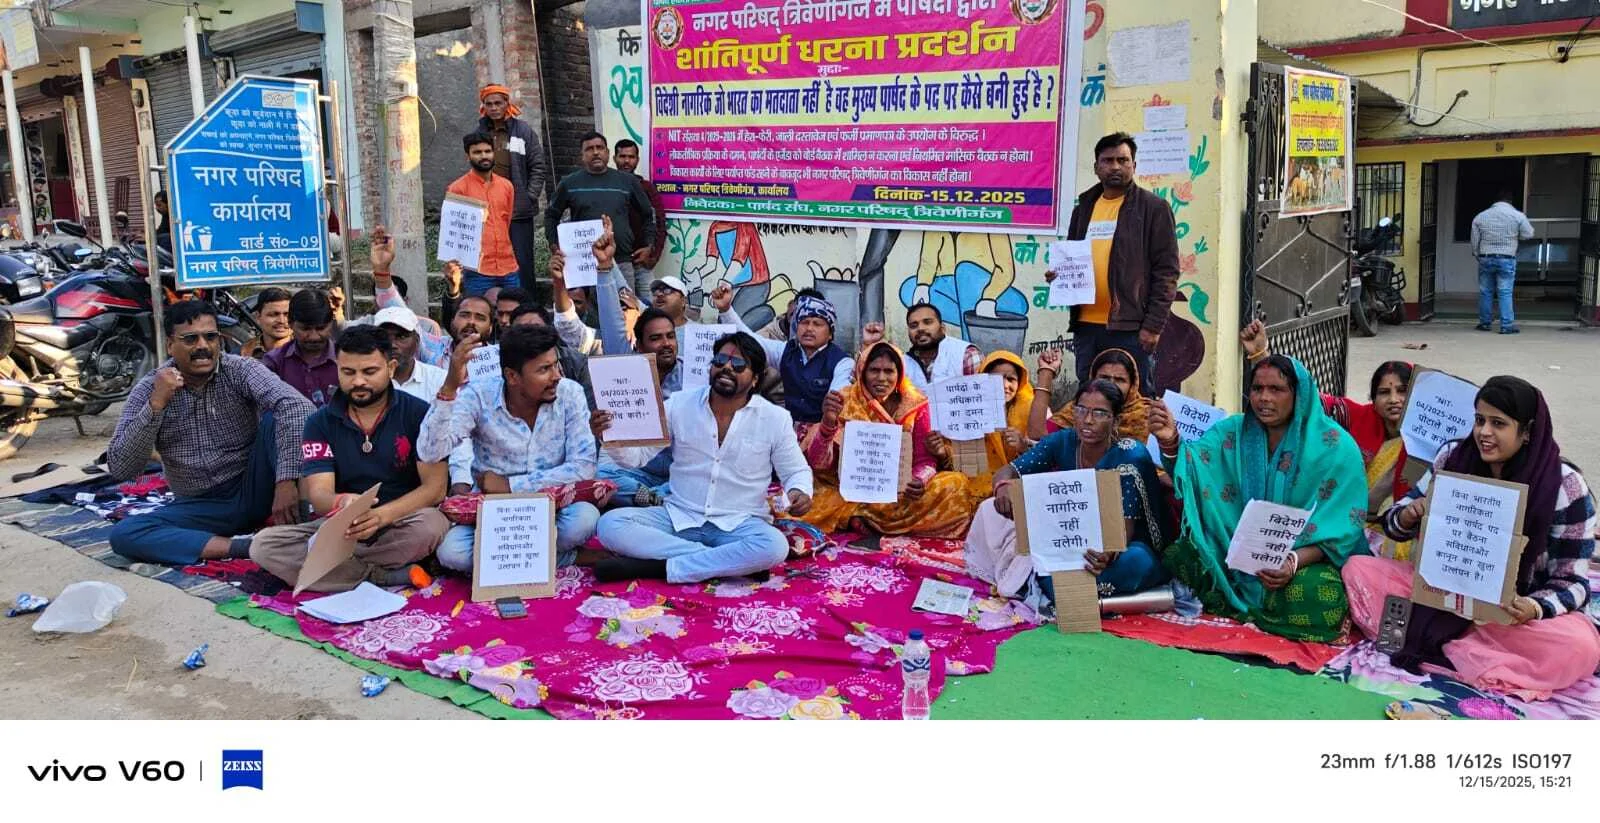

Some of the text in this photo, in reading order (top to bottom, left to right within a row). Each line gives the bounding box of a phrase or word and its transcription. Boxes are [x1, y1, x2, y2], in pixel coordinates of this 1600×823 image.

[692, 12, 728, 32] नगर
[730, 2, 781, 33] परिषद्
[676, 20, 1020, 74] शांतिपूर्ण धरना प्रदर्शन
[655, 69, 1054, 122] विदेशी नागरिक जो भारत का मतदाता नहीं है वह मुख्य पार्षद के पद पर कैसे बनी हुई है ?
[776, 129, 794, 141] जाली
[840, 128, 858, 141] फर्जी
[896, 128, 905, 141] के
[907, 128, 936, 141] उपयोग
[938, 128, 947, 141] के
[950, 128, 979, 142] विरुद्ध
[946, 148, 975, 161] मासिक
[977, 148, 998, 162] बैठक
[1000, 150, 1007, 161] न
[191, 160, 302, 188] नगर परिषद
[890, 168, 902, 179] का
[904, 167, 930, 181] विकास
[932, 168, 948, 181] नहीं
[682, 184, 698, 193] नगर
[758, 184, 789, 197] कार्यालय
[873, 186, 1025, 203] दिनांक-15.12.2025
[209, 195, 291, 222] कार्यालय
[747, 200, 782, 212] पार्षद
[785, 200, 813, 213] संघ,
[818, 204, 856, 216] नगर
[858, 204, 913, 219] परिषद्
[913, 205, 1003, 220] त्रिवेणीगंज
[239, 232, 264, 249] वार्ड
[1014, 234, 1040, 265] को
[188, 254, 319, 274] नगर परिषद् त्रिवेणीगंज
[965, 408, 984, 416] दमन
[1180, 404, 1210, 424] विदेशी
[1416, 400, 1466, 427] 04/2025-2026
[1418, 413, 1458, 437] घोटाले की
[1048, 481, 1082, 497] विदेशी
[1452, 489, 1501, 507] बिना भारतीय
[1045, 500, 1088, 514] नागरिक
[1456, 503, 1493, 519] नागरिकता
[1059, 517, 1080, 531] नहीं
[1269, 513, 1306, 529] विदेशी
[1464, 519, 1483, 531] पार्षद
[1488, 525, 1499, 535] पद
[1452, 529, 1488, 545] पर बैठना
[1436, 550, 1495, 572] कानून का खुला
